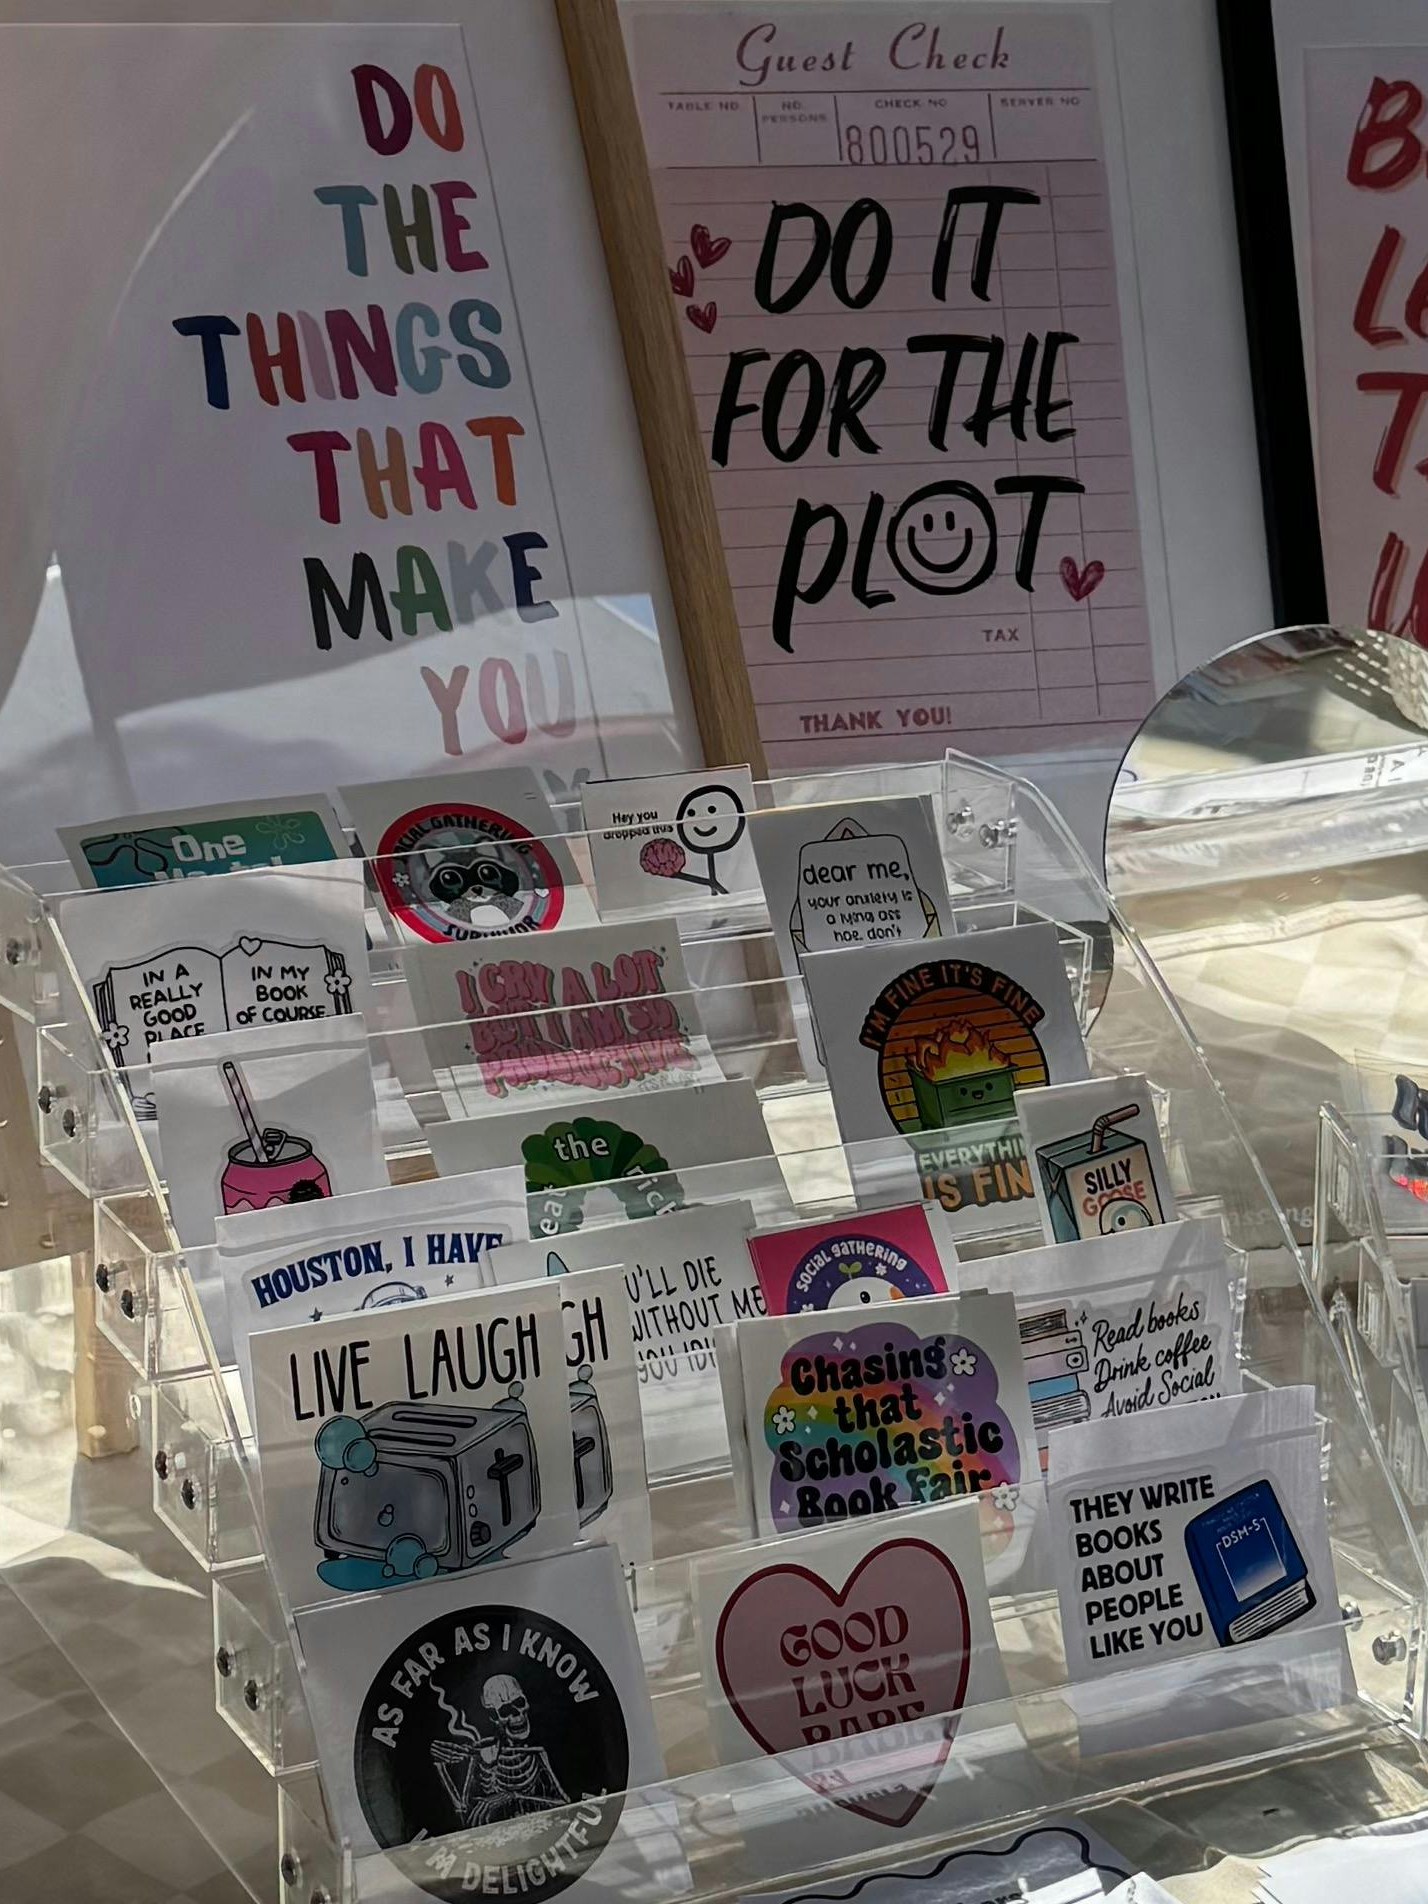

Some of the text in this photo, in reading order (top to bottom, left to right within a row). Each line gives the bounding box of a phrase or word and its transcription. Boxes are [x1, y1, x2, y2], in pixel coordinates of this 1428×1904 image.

[736, 22, 1011, 86] Guest Check
[351, 64, 465, 156] DO
[875, 99, 921, 110] CHECK
[846, 125, 980, 166] 800529
[314, 180, 490, 277] THE
[754, 186, 1041, 316] DO IT
[172, 298, 512, 410] THINGS
[712, 332, 1080, 469] FOR THE
[287, 416, 526, 524] THAT
[304, 531, 560, 651] MAKE
[982, 628, 1021, 643] TAX
[421, 649, 577, 756] YOU
[800, 706, 953, 733] THANK YOU!
[612, 811, 658, 824] Hey you
[172, 834, 247, 862] One
[803, 861, 909, 885] dear me,
[808, 891, 897, 910] your anxiety
[840, 912, 874, 925] lying
[867, 924, 901, 939] don't
[129, 983, 204, 1010] REALLY
[143, 964, 190, 987] IN A
[252, 965, 310, 981] IN MY
[256, 985, 309, 1001] BOOK
[591, 949, 665, 999] LOT
[887, 963, 1041, 1024] FINE IT'S FINE
[143, 1003, 197, 1027] GOOD
[145, 1023, 205, 1046] PLACE
[236, 1006, 257, 1024] OF
[539, 1133, 609, 1236] eat the
[923, 1174, 962, 1211] IS
[1084, 1158, 1134, 1195] SILLY
[251, 1236, 415, 1309] HOUSTON, I
[684, 1255, 721, 1292] DIE
[731, 1286, 767, 1319] ME
[1092, 1291, 1200, 1357] Read books
[290, 1341, 373, 1421] LIVE
[404, 1313, 540, 1400] LAUGH
[791, 1336, 947, 1395] Chasing
[1094, 1329, 1212, 1393] Drink coffee
[833, 1383, 922, 1433] that
[1100, 1355, 1216, 1418] Avoid Social
[779, 1412, 1004, 1482] Scholastic
[796, 1460, 992, 1528] Book Fair
[1070, 1474, 1215, 1523] THEY WRITE
[1075, 1519, 1162, 1558] BOOKS
[1082, 1553, 1164, 1592] ABOUT
[1085, 1583, 1184, 1626] PEOPLE
[780, 1605, 909, 1667] GOOD
[1090, 1612, 1204, 1659] LIKE YOU
[372, 1622, 600, 1749] AS FAR AS I KNOW
[792, 1653, 917, 1718] LUCK
